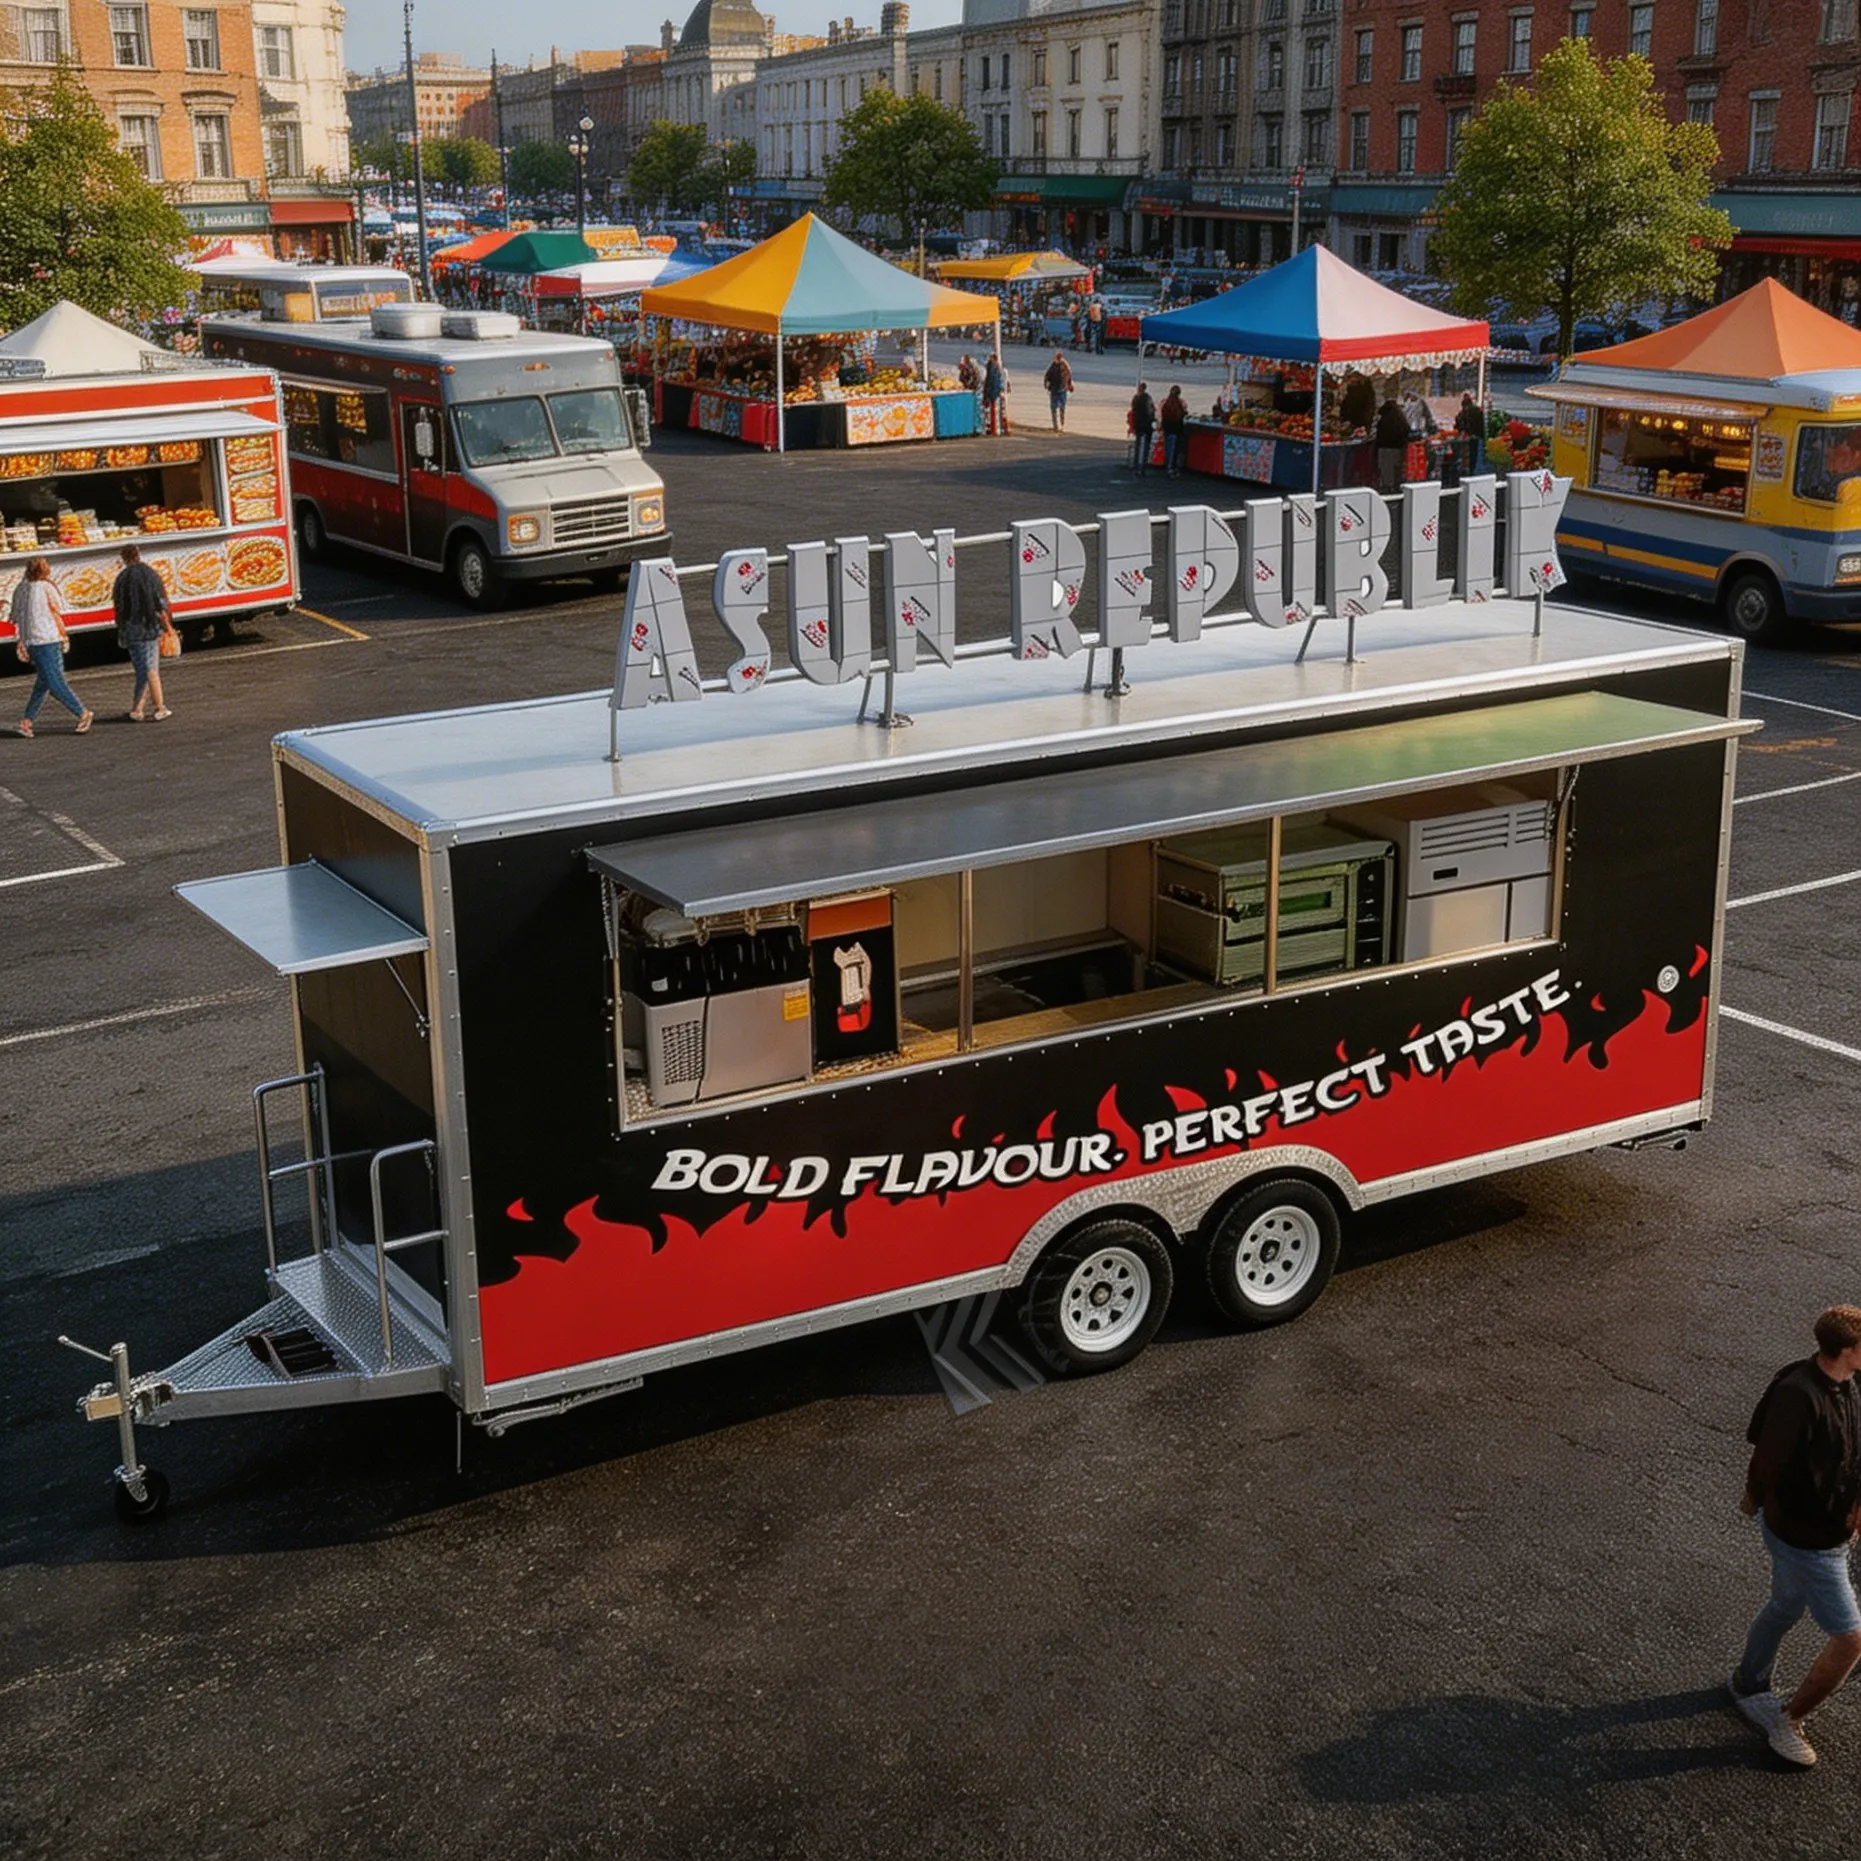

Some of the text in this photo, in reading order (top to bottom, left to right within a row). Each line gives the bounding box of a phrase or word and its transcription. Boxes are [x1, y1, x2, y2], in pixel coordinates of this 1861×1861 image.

[613, 468, 1575, 710] ASUN REPUBLIK
[651, 968, 1584, 1198] BOLD FLAVOUR. PERFECT TASTE.
